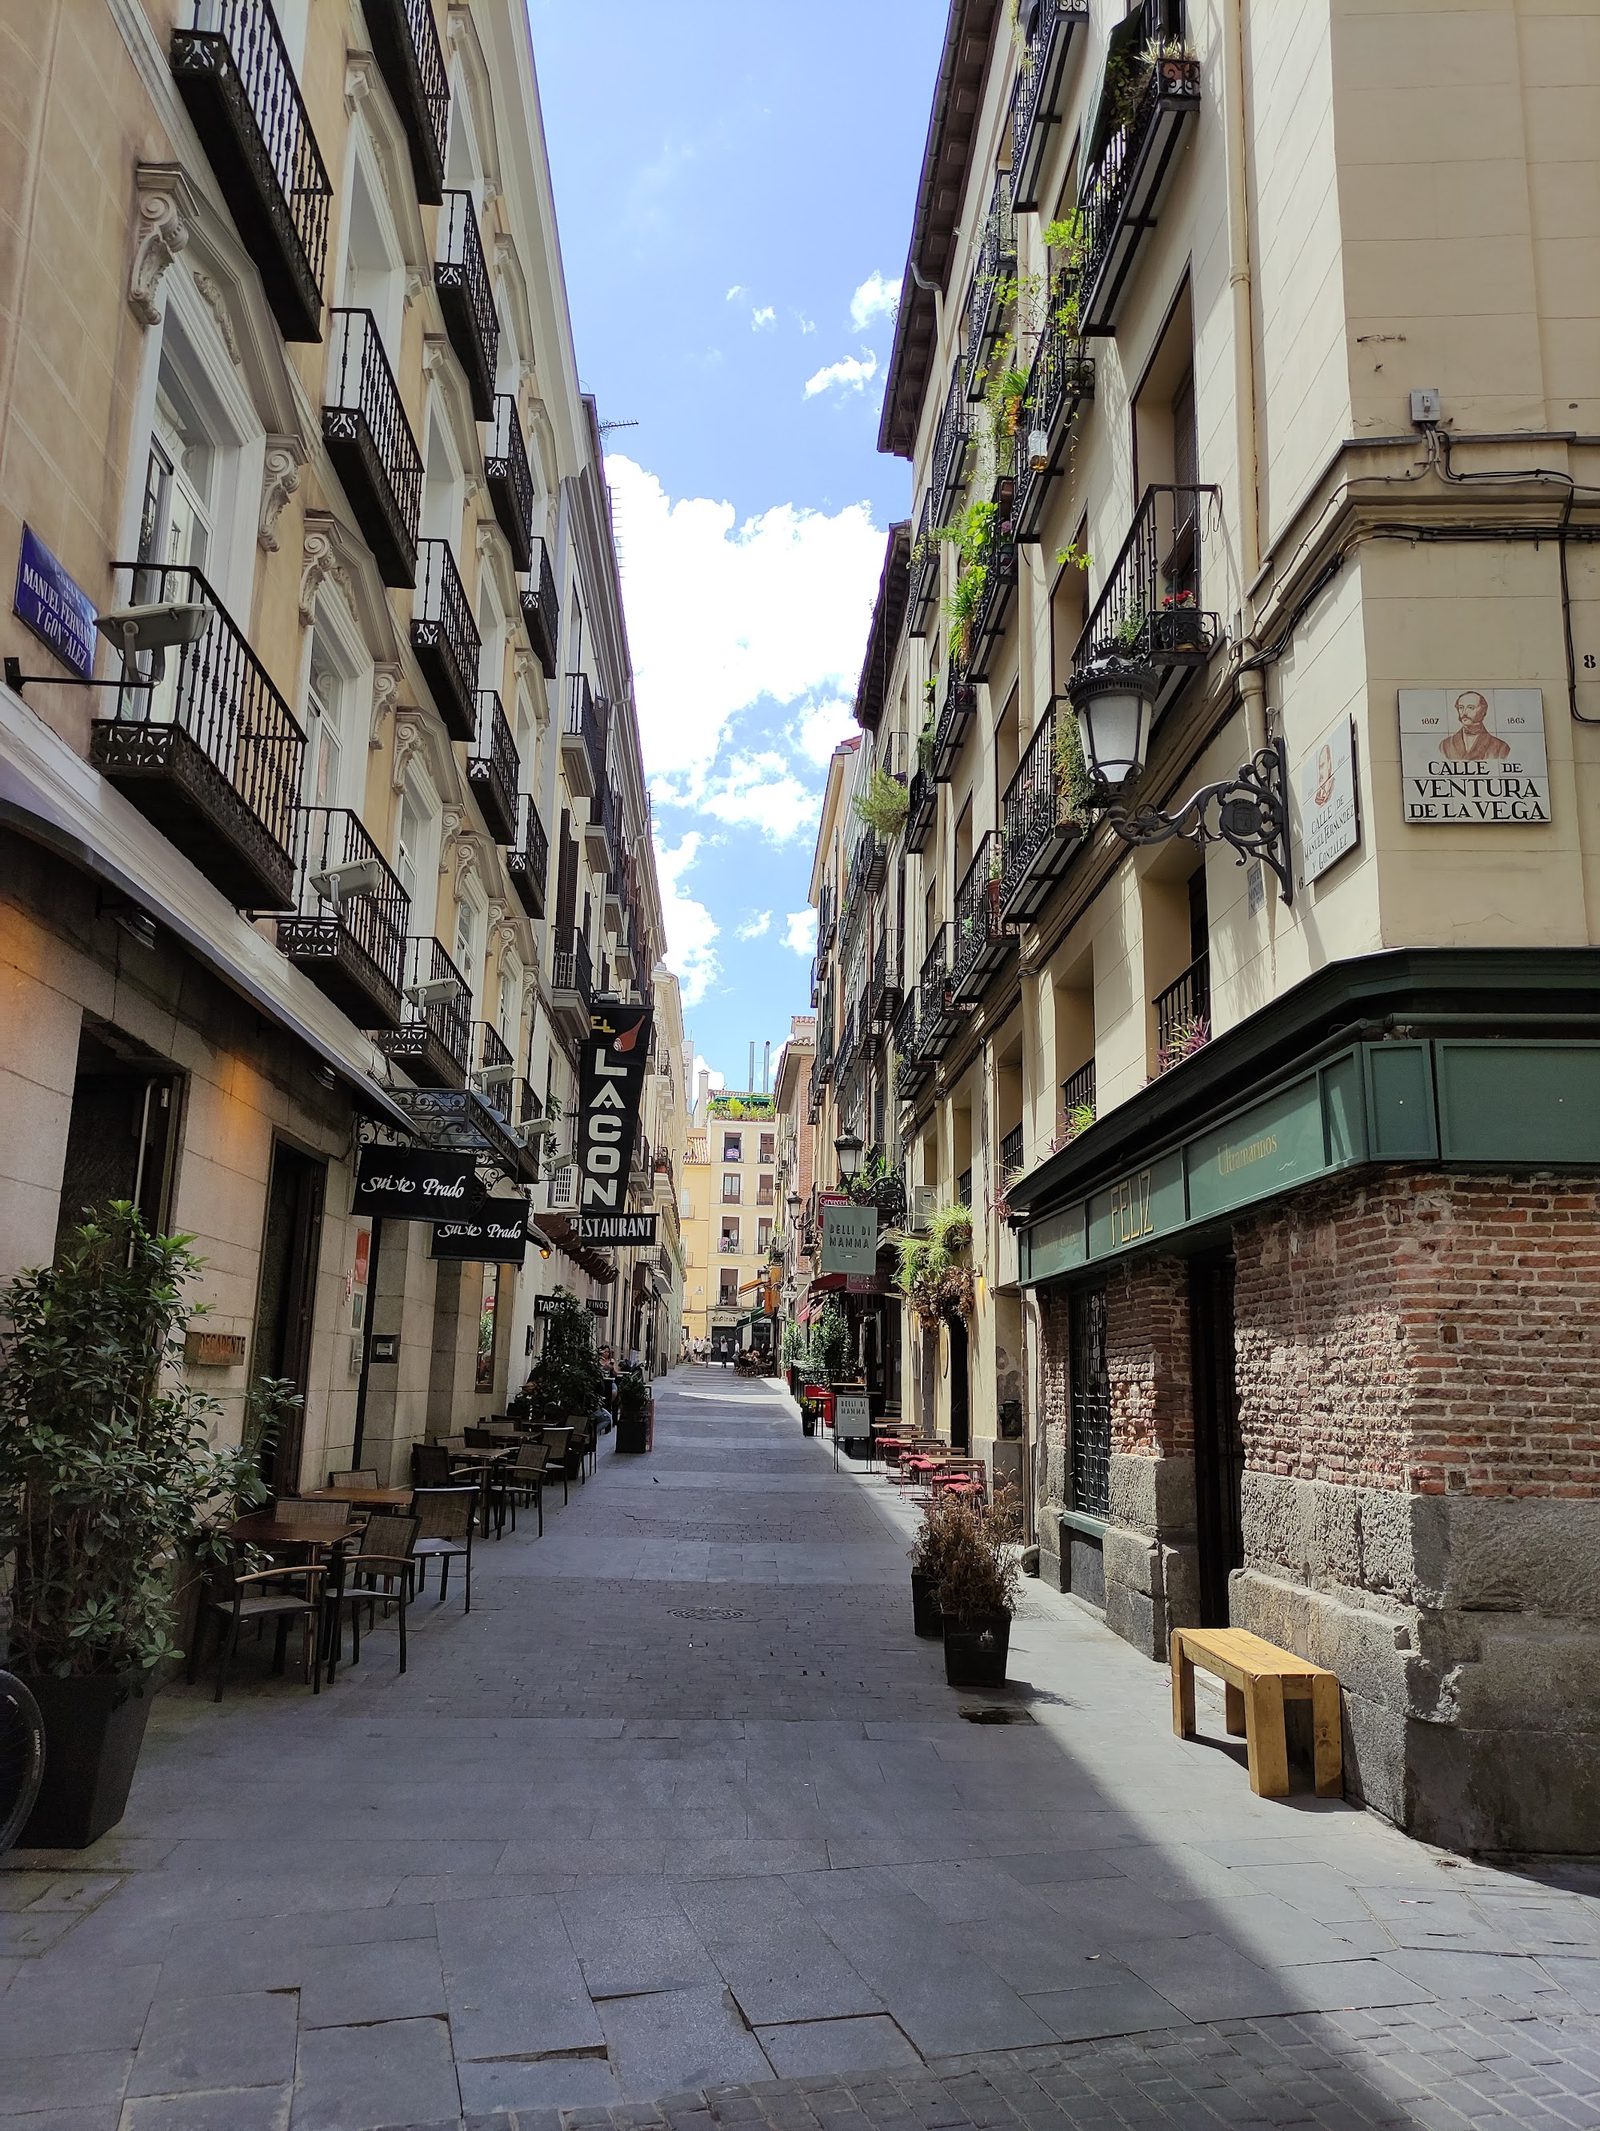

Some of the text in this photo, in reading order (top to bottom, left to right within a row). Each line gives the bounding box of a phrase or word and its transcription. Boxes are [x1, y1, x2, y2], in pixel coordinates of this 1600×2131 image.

[23, 563, 60, 615] MANUEL
[36, 601, 46, 625] Y
[1583, 654, 1597, 669] 8
[1428, 761, 1523, 776] CALLE DE
[1414, 778, 1541, 800] VENTURA
[1311, 794, 1345, 836] CALLE DE
[1408, 800, 1550, 820] DE LA VEGA
[591, 1015, 616, 1034] EL
[583, 1048, 628, 1207] LACON
[1217, 1133, 1278, 1177] Ultramarinos
[422, 1175, 466, 1198] Prado
[1110, 1168, 1155, 1248] FELIZ
[487, 1220, 522, 1239] Prado
[570, 1217, 653, 1238] RESTAURANT
[830, 1224, 871, 1236] BELLI DI
[829, 1237, 870, 1249] MAMMA
[587, 1300, 609, 1310] VINOS
